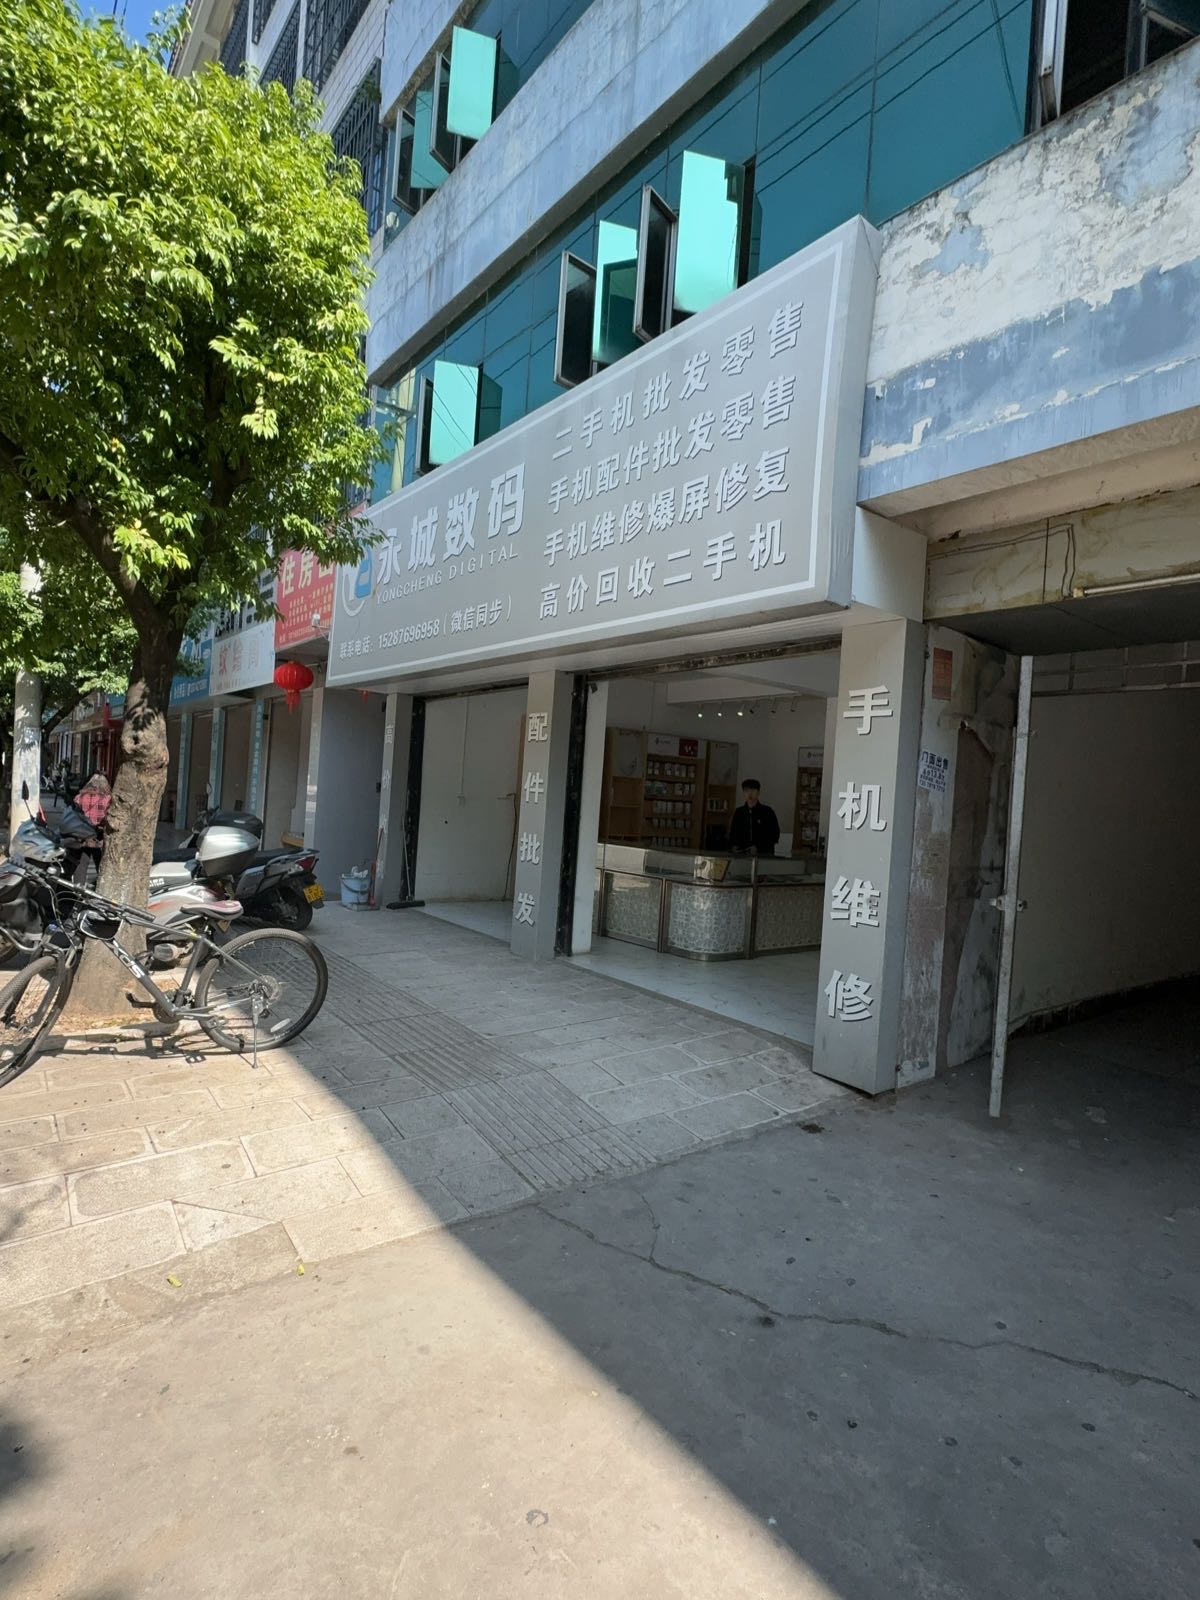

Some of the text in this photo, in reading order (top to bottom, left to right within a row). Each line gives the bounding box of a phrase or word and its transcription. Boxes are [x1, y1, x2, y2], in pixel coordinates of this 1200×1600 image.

[547, 375, 797, 514] 手机配件批发零售
[552, 301, 804, 460] 二手机批发零售
[376, 462, 526, 585] 永城数码
[539, 519, 787, 620] 高价回收二手机
[543, 447, 790, 567] 手机维修爆屏修复
[376, 571, 443, 604] YONGCHENG
[449, 543, 518, 581] DIGITAL
[515, 712, 548, 926] 配件批发
[824, 684, 894, 1022] 手机维修
